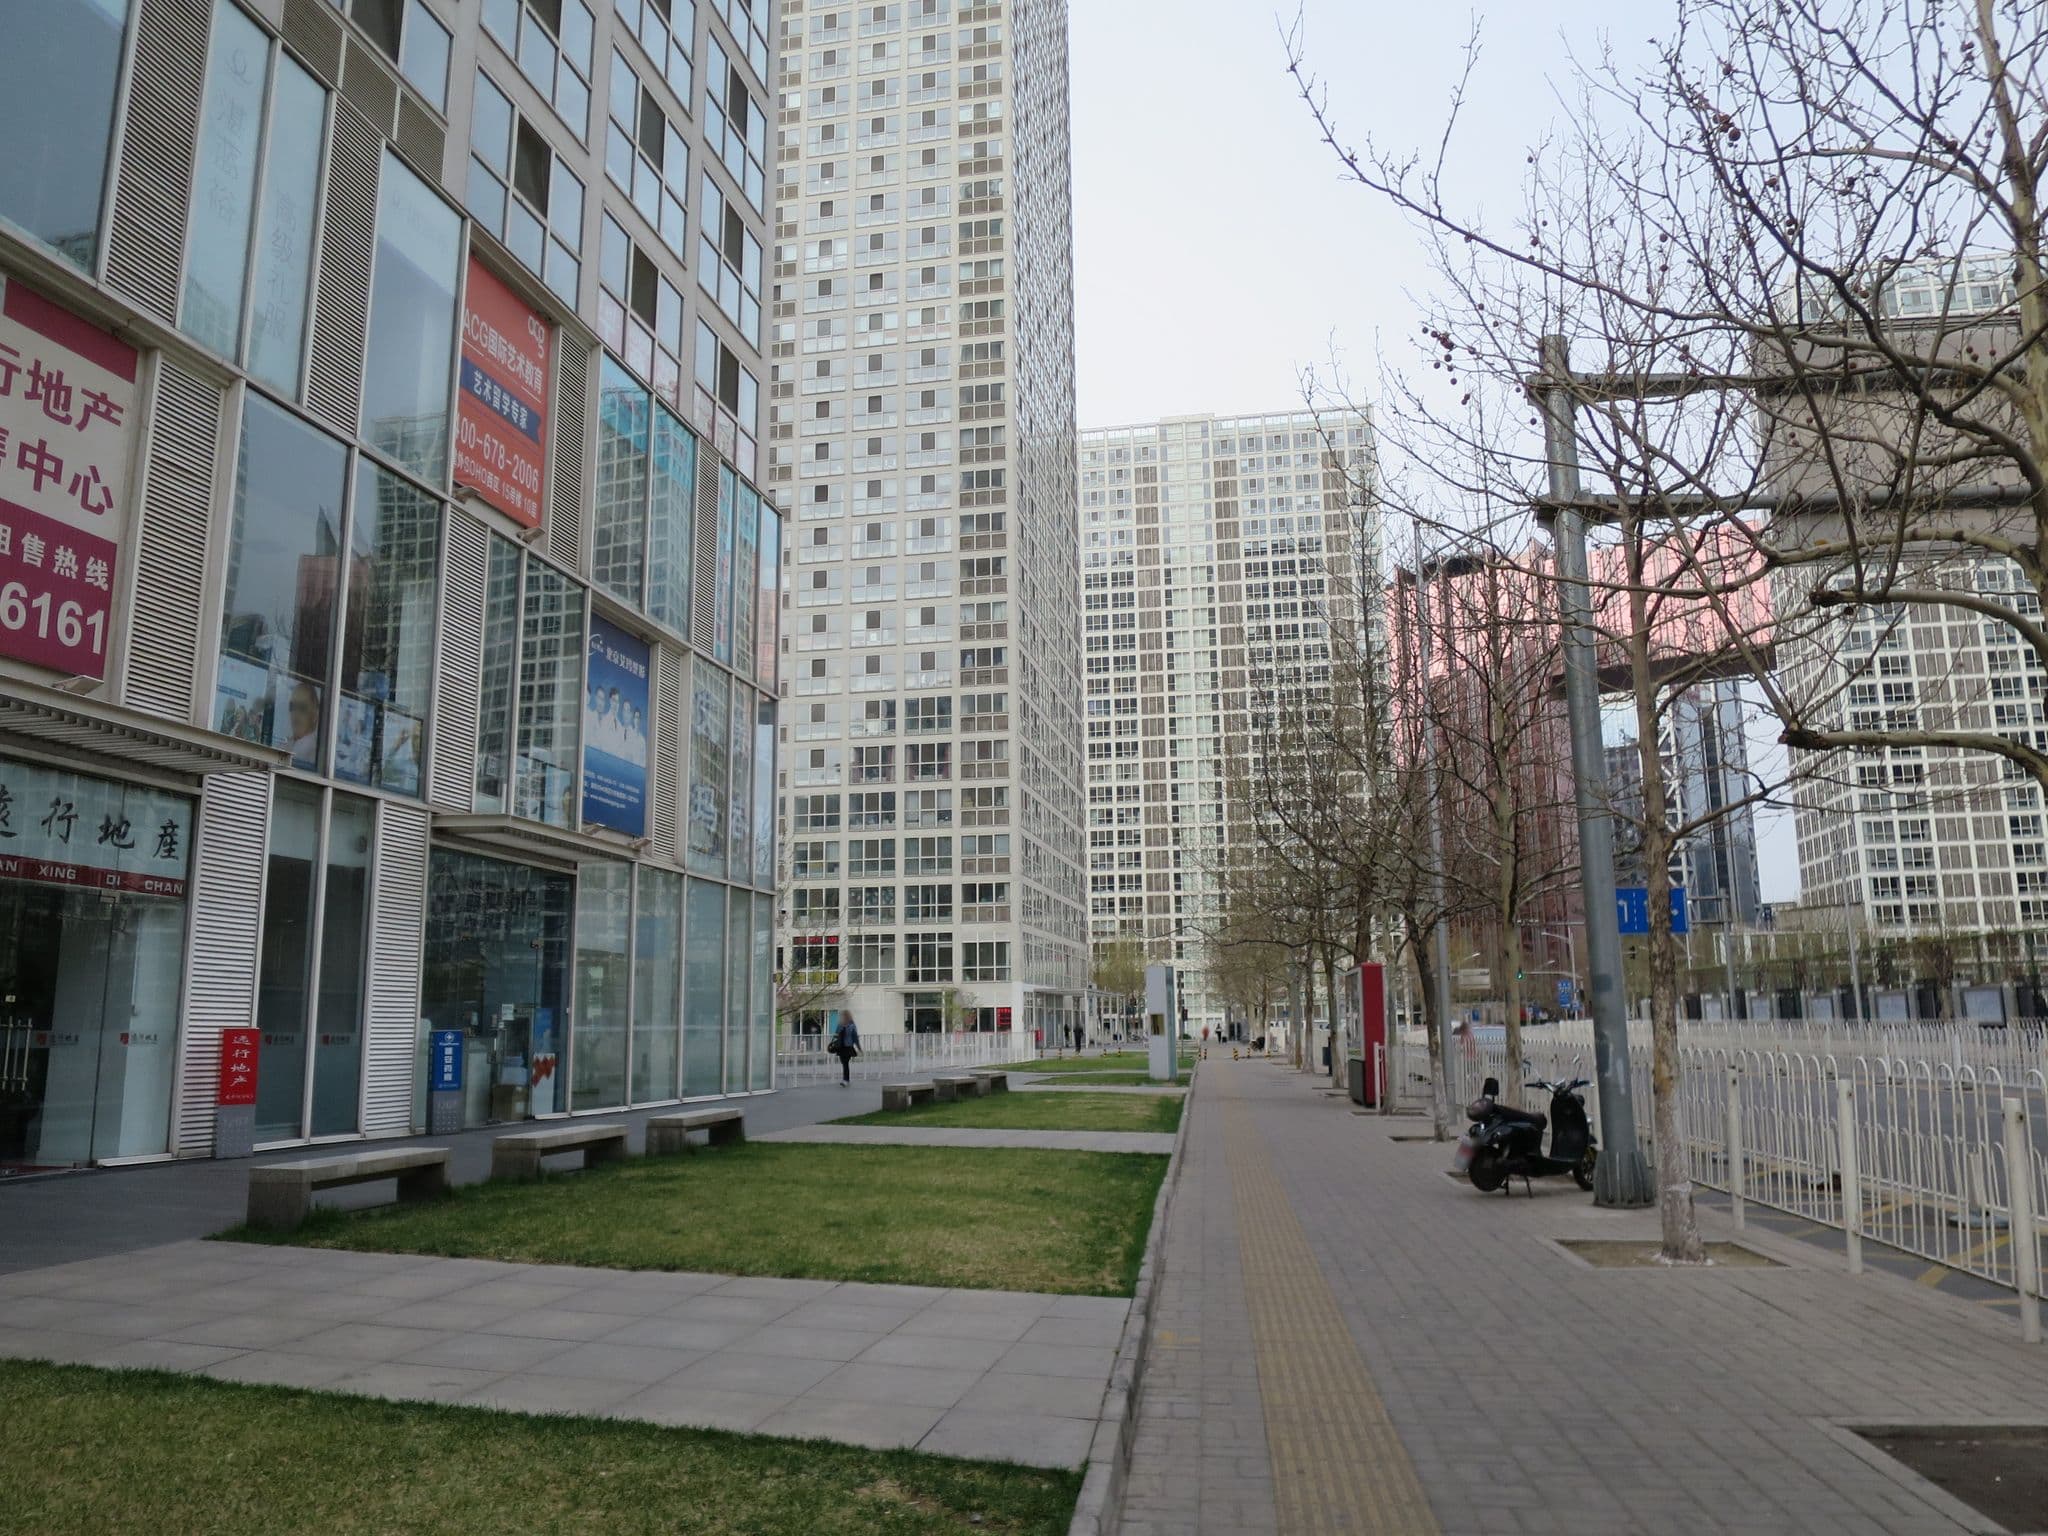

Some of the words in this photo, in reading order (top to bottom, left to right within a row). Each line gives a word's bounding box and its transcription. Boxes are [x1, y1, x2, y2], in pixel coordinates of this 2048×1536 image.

[474, 370, 528, 430] 艺术留学专家
[0, 427, 114, 516] 中心
[0, 581, 105, 655] 6161
[38, 864, 77, 880] XING
[106, 874, 121, 887] DI
[144, 879, 184, 895] CHAN
